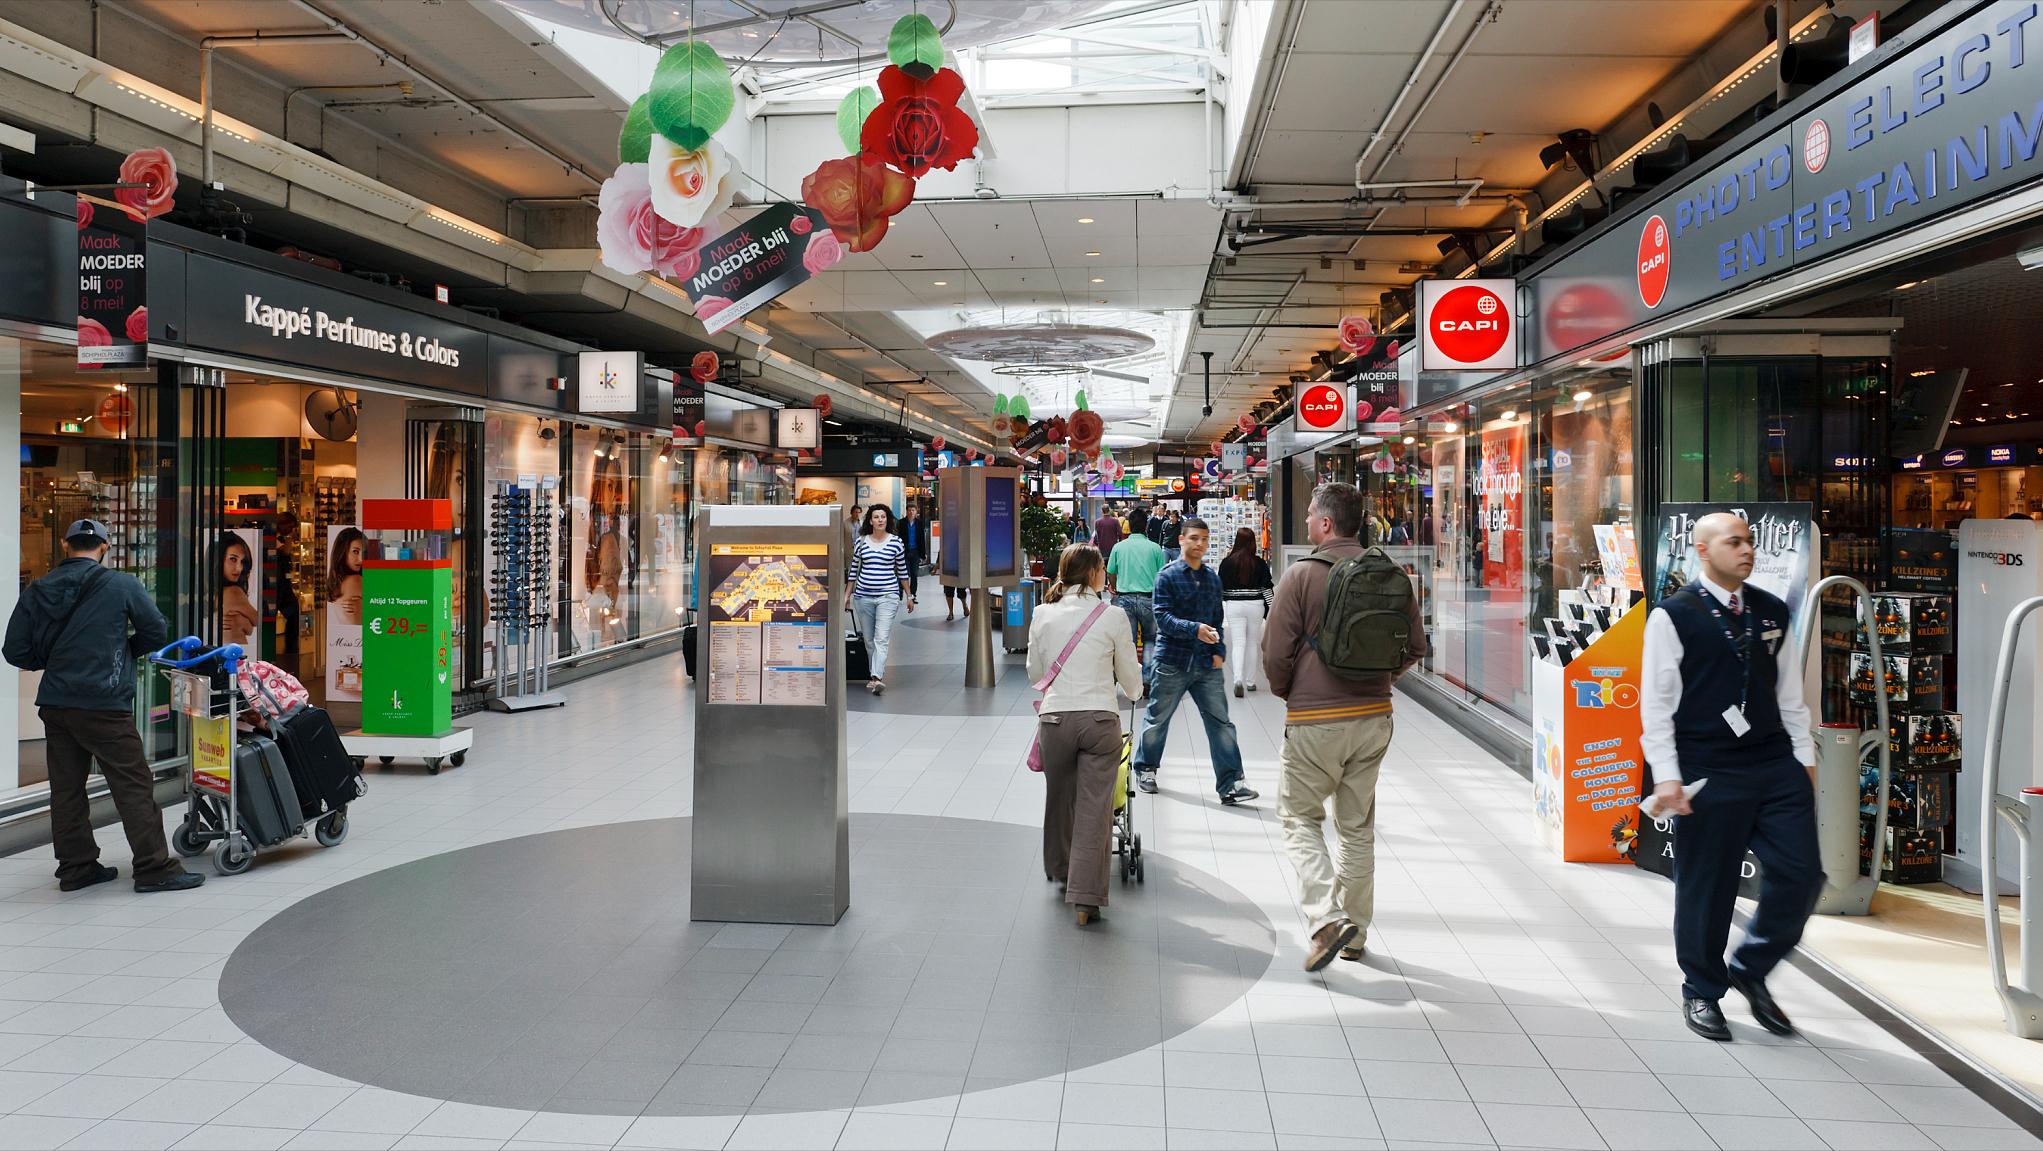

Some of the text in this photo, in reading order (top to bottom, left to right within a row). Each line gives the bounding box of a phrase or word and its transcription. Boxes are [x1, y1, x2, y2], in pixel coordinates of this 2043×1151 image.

[1846, 3, 2038, 152] ELECT
[1675, 143, 1792, 239] PHOTO
[1719, 100, 2043, 282] ENTERTAINM
[80, 233, 121, 250] Maak
[710, 231, 754, 264] Maak
[80, 254, 145, 270] MOEDER
[692, 227, 790, 293] MOEDER blij
[1641, 252, 1665, 274] CAPI
[722, 247, 787, 293] op 8 mei!
[80, 275, 124, 294] blij op
[80, 295, 125, 311] 8 mei!
[245, 294, 460, 368] Kappé Perfumes & Colors
[1439, 319, 1499, 332] CAPI
[1359, 371, 1398, 381] MOEDER
[1371, 382, 1384, 394] blij
[673, 397, 704, 405] MOEDER
[1305, 402, 1338, 412] CAPI
[1967, 551, 2024, 567] NINTENDO 3DS
[1891, 566, 1949, 577] KILLZONE 3
[369, 597, 428, 606] Altijd 12 Topgeuren
[369, 617, 383, 635] €
[1861, 624, 1898, 635] KZONE
[1917, 626, 1945, 636] KILLZONE
[438, 671, 447, 685] €
[1856, 682, 1895, 694] KILLNE
[198, 736, 225, 758] Sunweb
[1583, 737, 1622, 752] ENJOY
[1914, 745, 1952, 754] KILLZONE
[1576, 753, 1617, 765] THE MOST
[1571, 760, 1637, 779] COLOURFUL
[1584, 773, 1628, 788] MOVIES
[1577, 786, 1636, 802] ON DVD AND
[1592, 795, 1641, 811] BLU-RAY
[1901, 856, 1933, 866] KILLZONE
